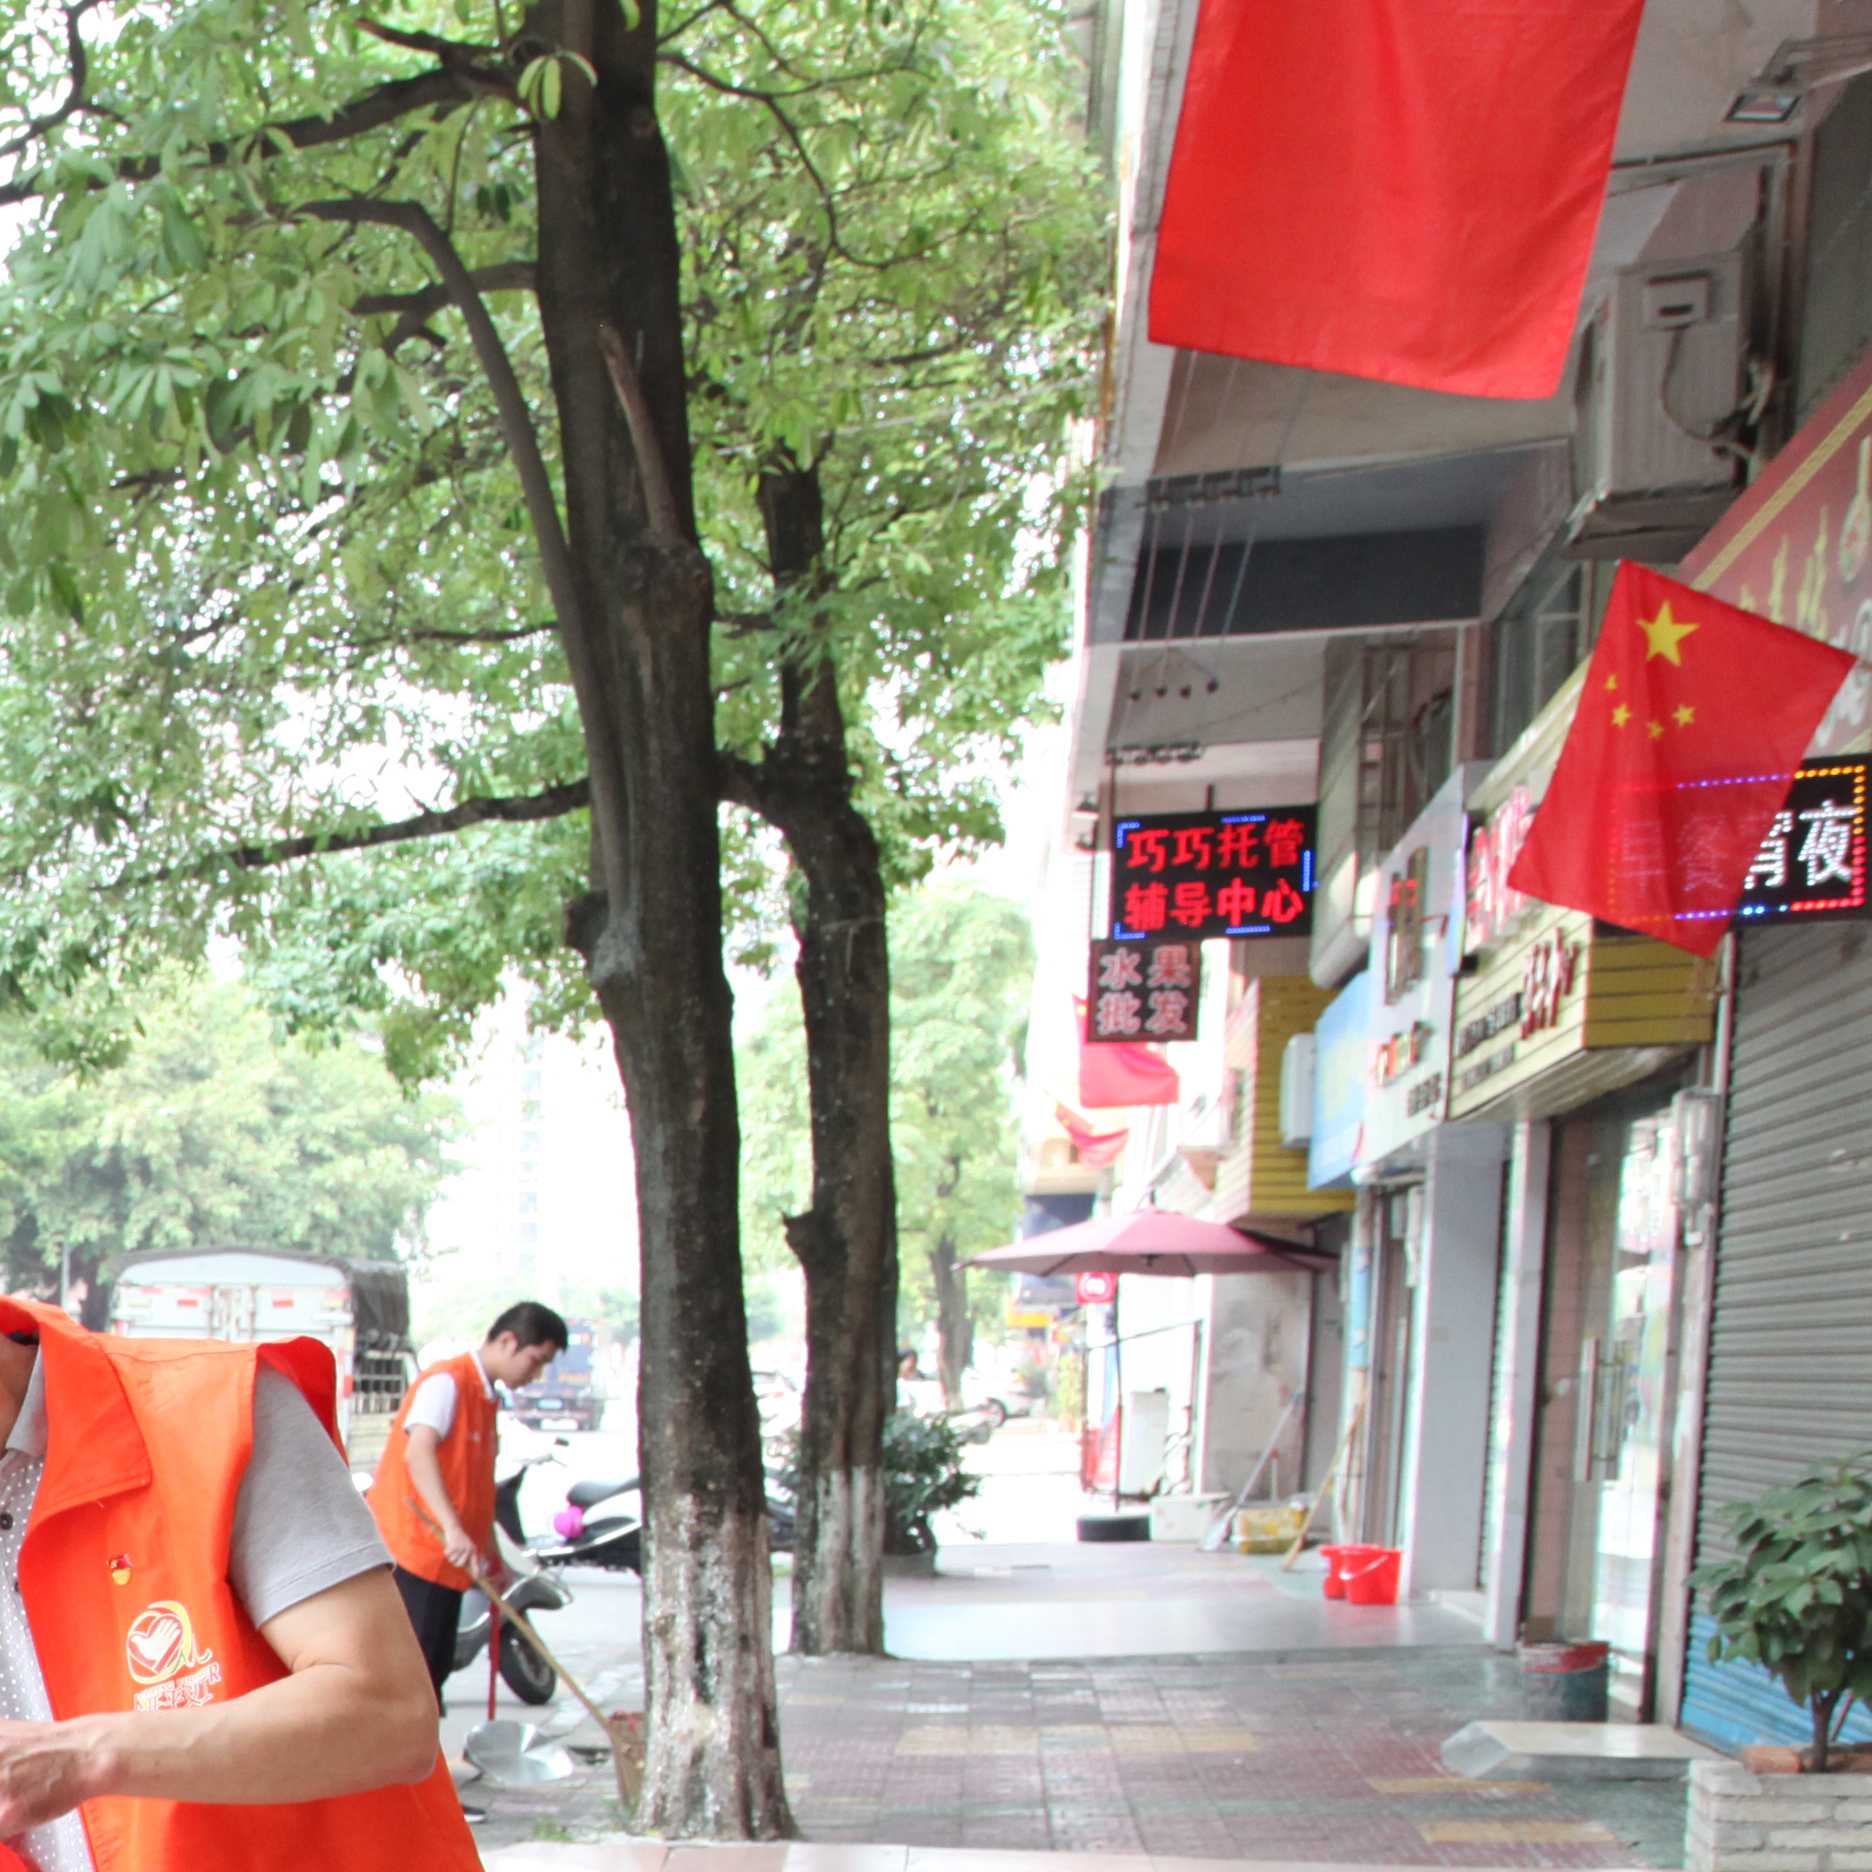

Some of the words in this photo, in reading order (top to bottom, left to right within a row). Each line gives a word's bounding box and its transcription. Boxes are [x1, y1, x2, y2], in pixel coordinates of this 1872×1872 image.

[1127, 818, 1305, 872] 巧巧托管
[1123, 876, 1306, 932] 辅导中心
[1098, 945, 1193, 991] 水果
[1096, 990, 1190, 1036] 批发
